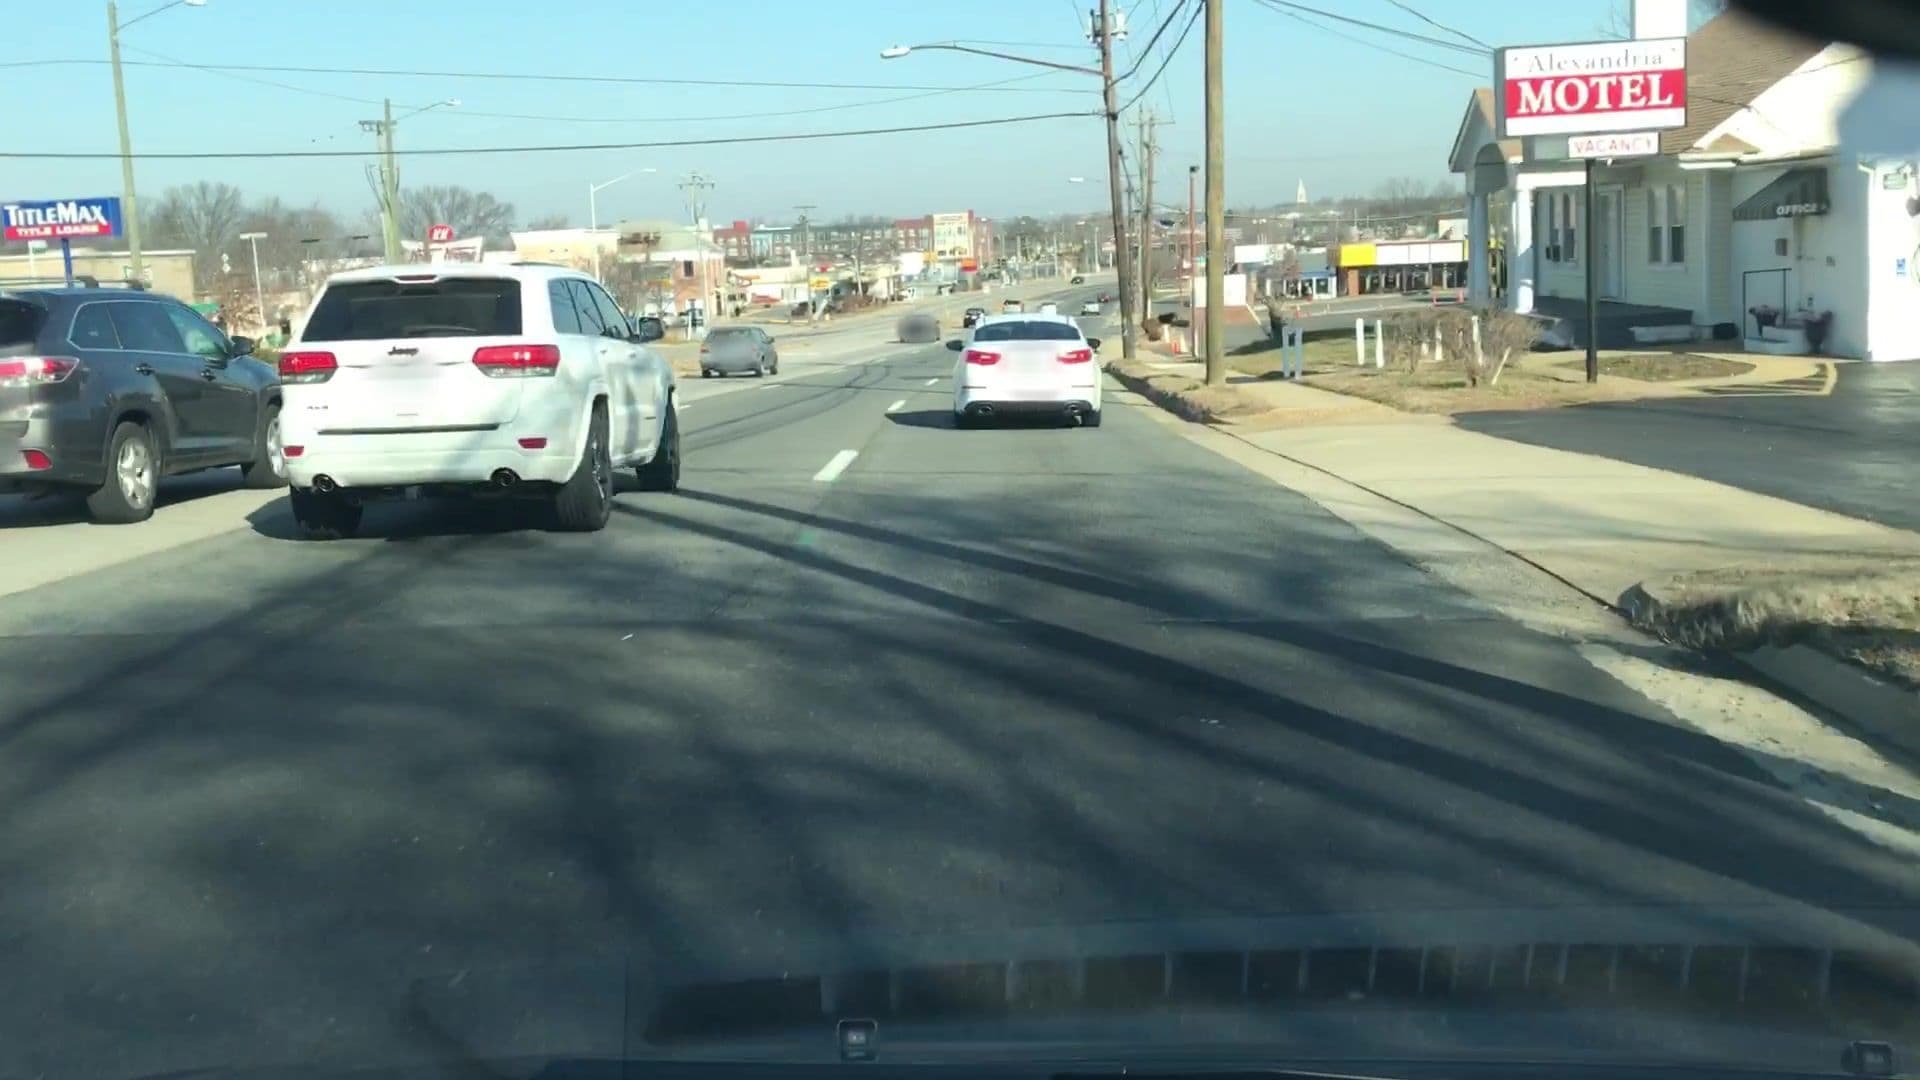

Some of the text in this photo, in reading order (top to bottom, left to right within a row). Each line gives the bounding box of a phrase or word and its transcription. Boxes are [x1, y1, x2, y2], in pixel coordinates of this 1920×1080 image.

[1528, 49, 1662, 73] Alexandria
[1517, 73, 1674, 114] MOTEL
[1573, 137, 1652, 155] VACANCY
[16, 223, 99, 237] TITLE LOANS
